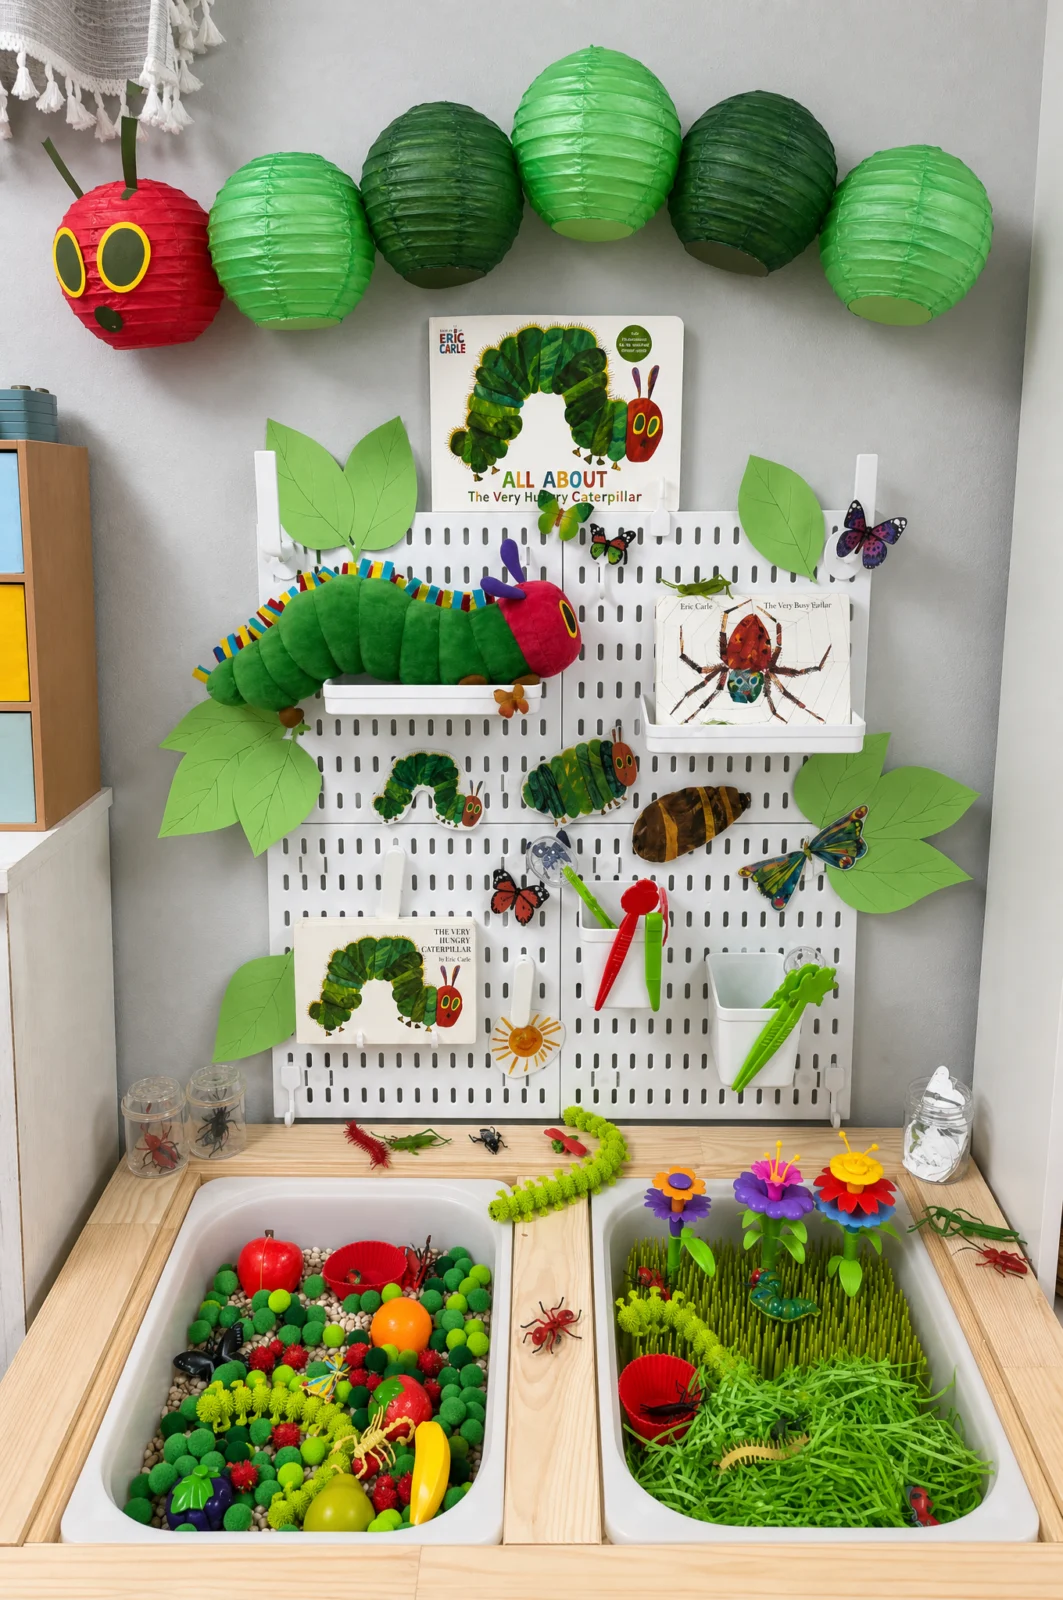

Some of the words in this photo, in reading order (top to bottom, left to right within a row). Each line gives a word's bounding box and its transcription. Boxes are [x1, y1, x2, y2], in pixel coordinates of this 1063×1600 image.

[440, 330, 464, 344] ERIC
[440, 344, 466, 354] CARLE
[502, 471, 534, 488] ALL
[543, 471, 608, 488] ABOUT
[468, 491, 490, 502] The
[493, 492, 520, 505] Very
[524, 492, 568, 504] Hury
[572, 490, 642, 506] Caterpillar
[778, 602, 793, 610] Very
[794, 602, 810, 610] Busy
